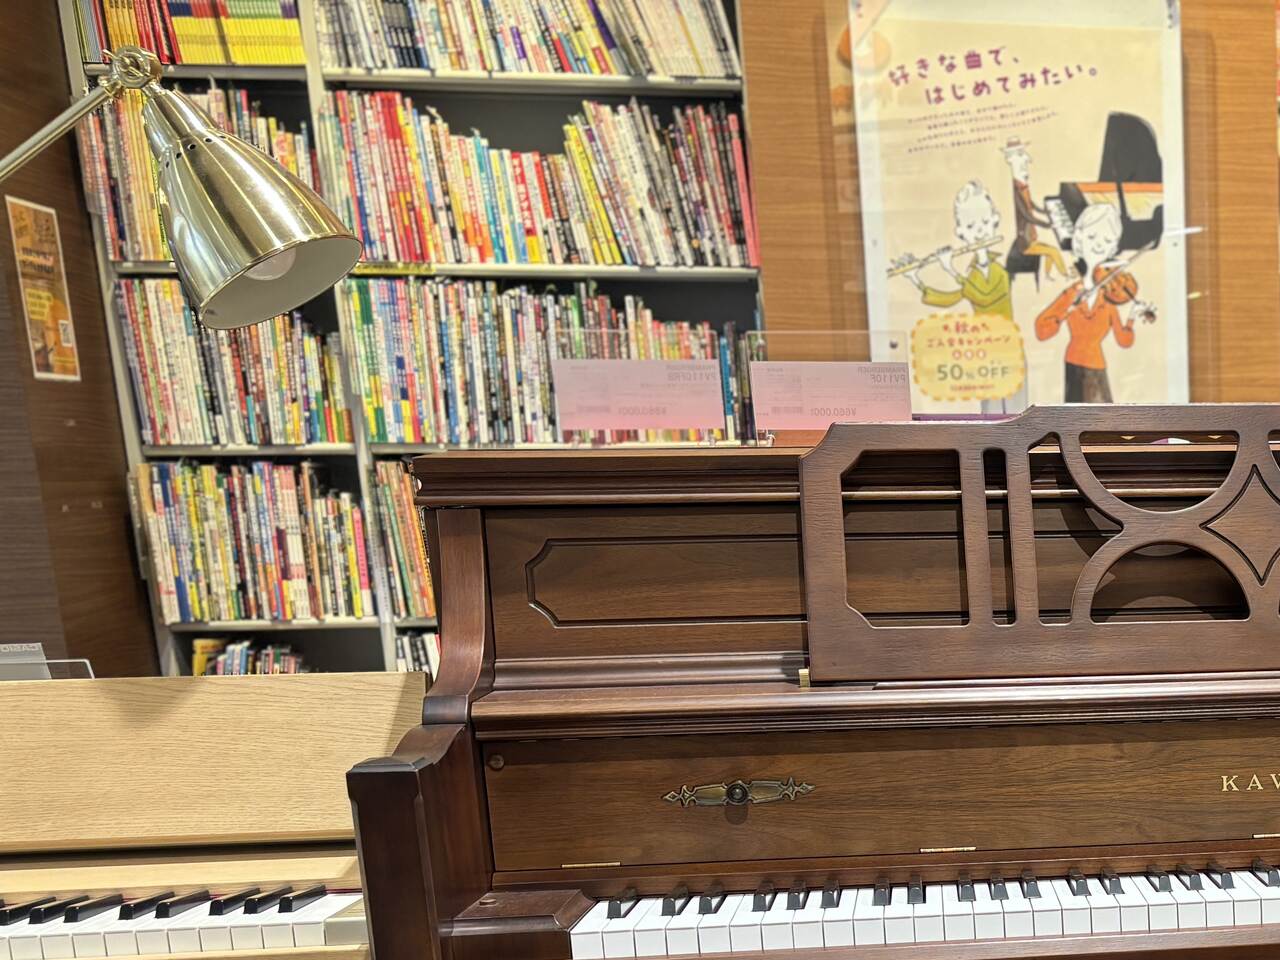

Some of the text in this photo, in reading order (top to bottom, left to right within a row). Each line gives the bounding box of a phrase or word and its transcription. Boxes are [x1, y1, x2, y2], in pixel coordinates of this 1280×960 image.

[925, 64, 1098, 105] はじめてみたい。
